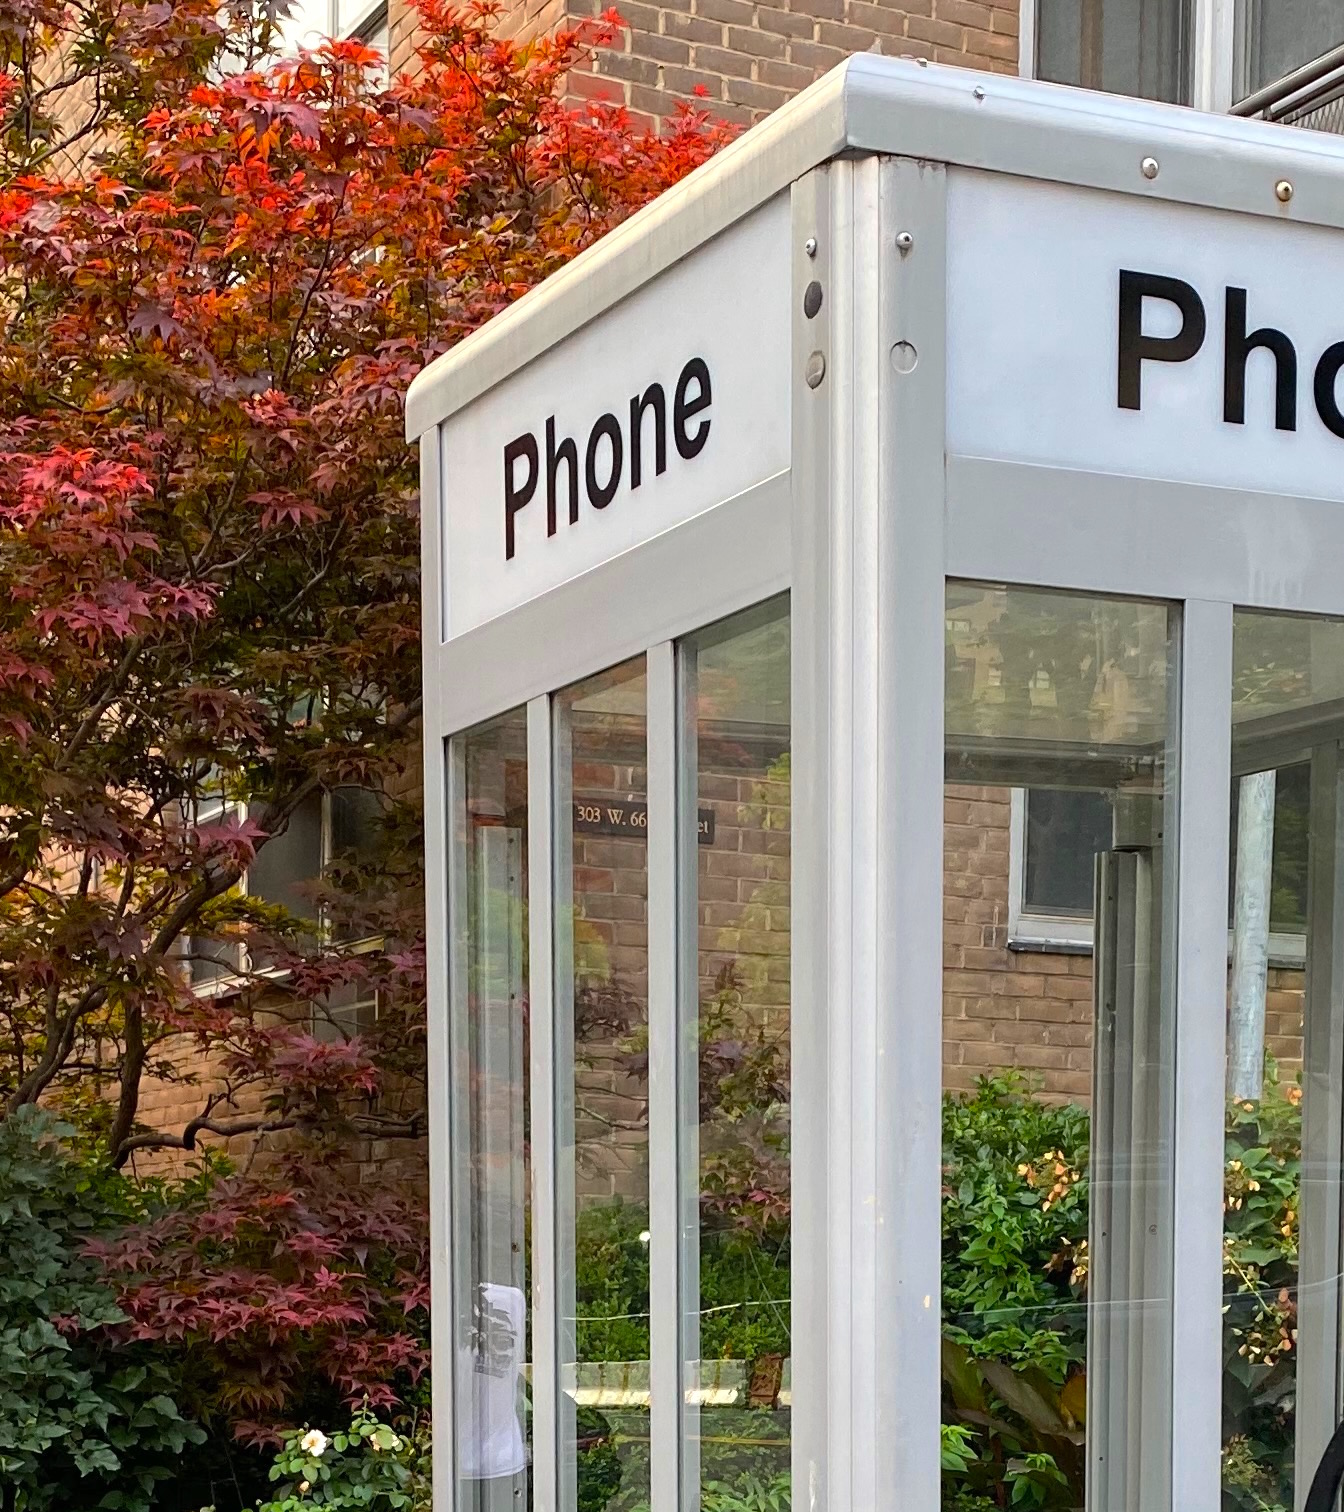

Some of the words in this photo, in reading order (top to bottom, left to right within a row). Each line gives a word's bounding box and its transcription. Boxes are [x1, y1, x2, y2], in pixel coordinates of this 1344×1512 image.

[503, 356, 712, 561] Phone
[576, 805, 601, 824] 303
[607, 807, 627, 826] W.
